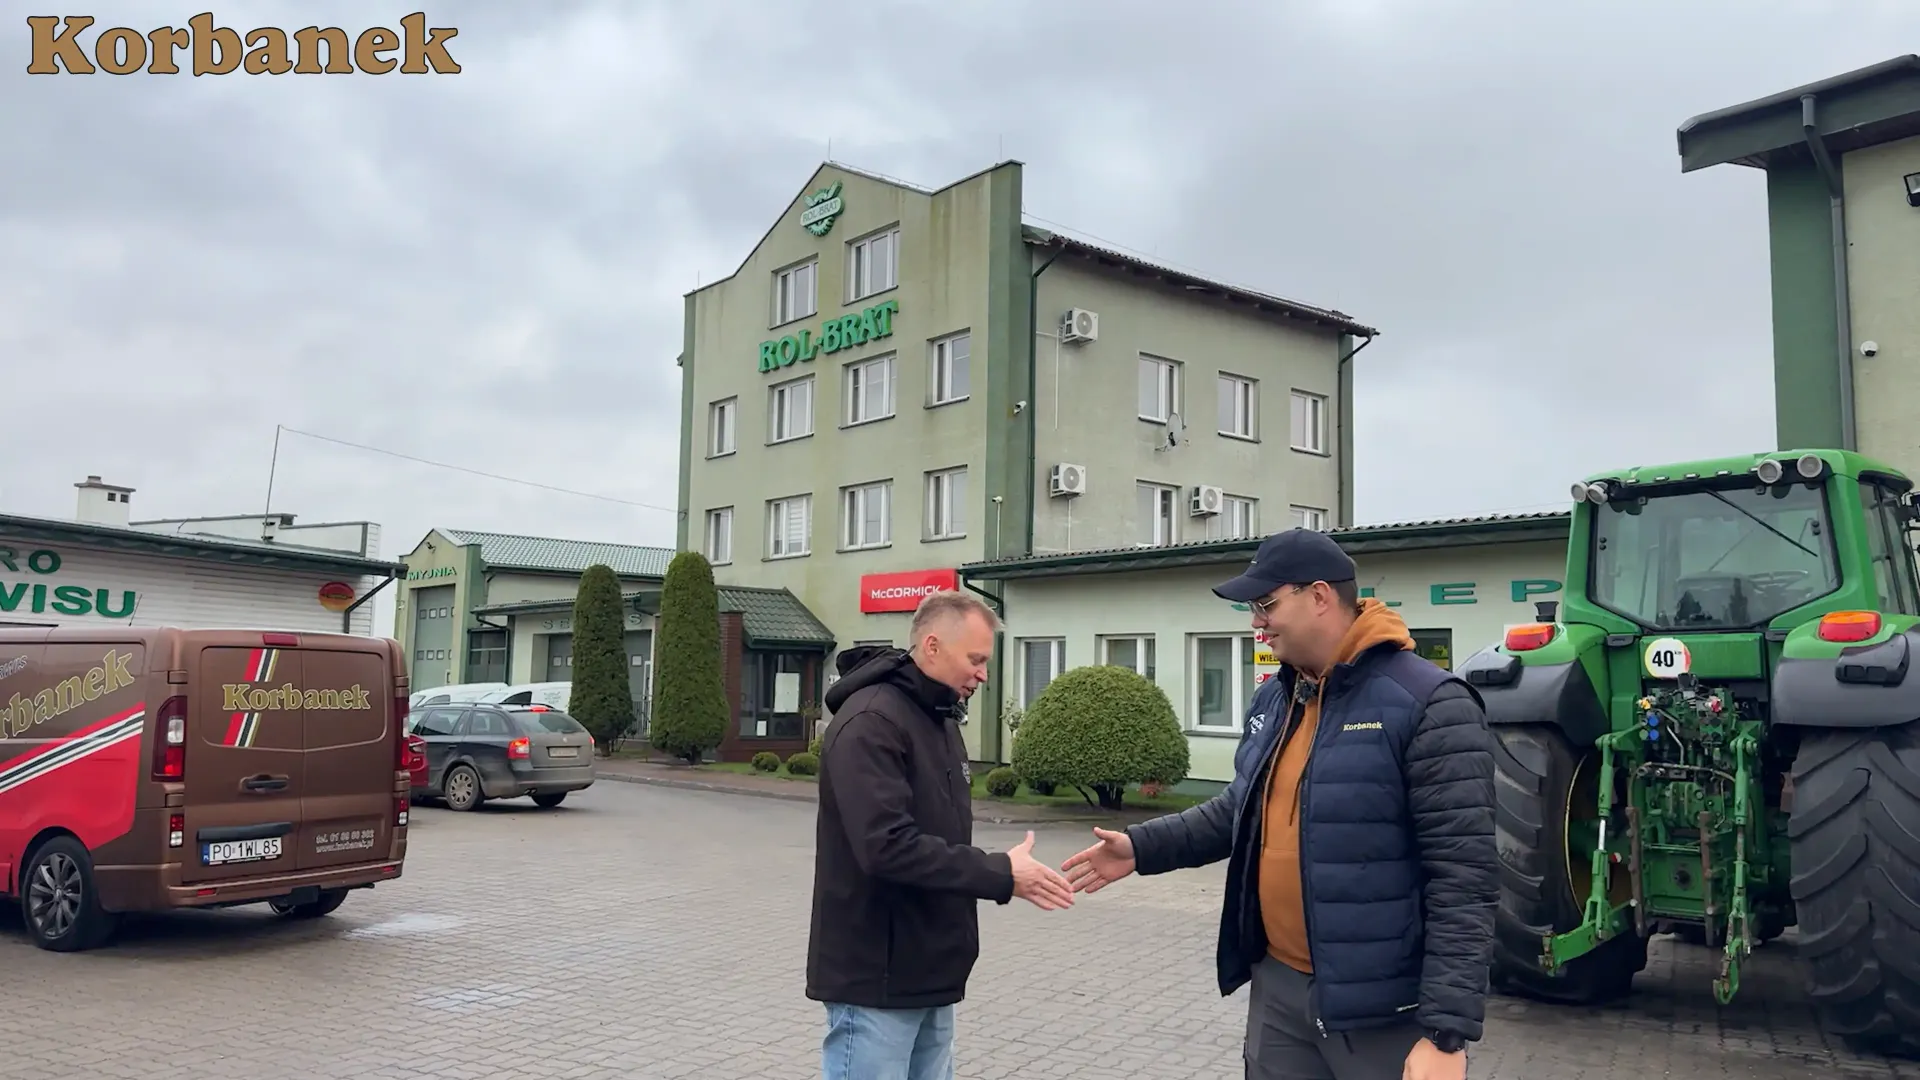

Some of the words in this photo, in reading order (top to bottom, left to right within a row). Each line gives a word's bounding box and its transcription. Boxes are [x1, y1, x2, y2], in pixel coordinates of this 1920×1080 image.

[408, 566, 457, 580] MYJNIA
[1652, 650, 1674, 668] 40
[222, 683, 371, 711] Korbanek
[1343, 721, 1383, 731] Korbanek
[212, 843, 232, 860] PO
[238, 839, 279, 858] 1WL85
